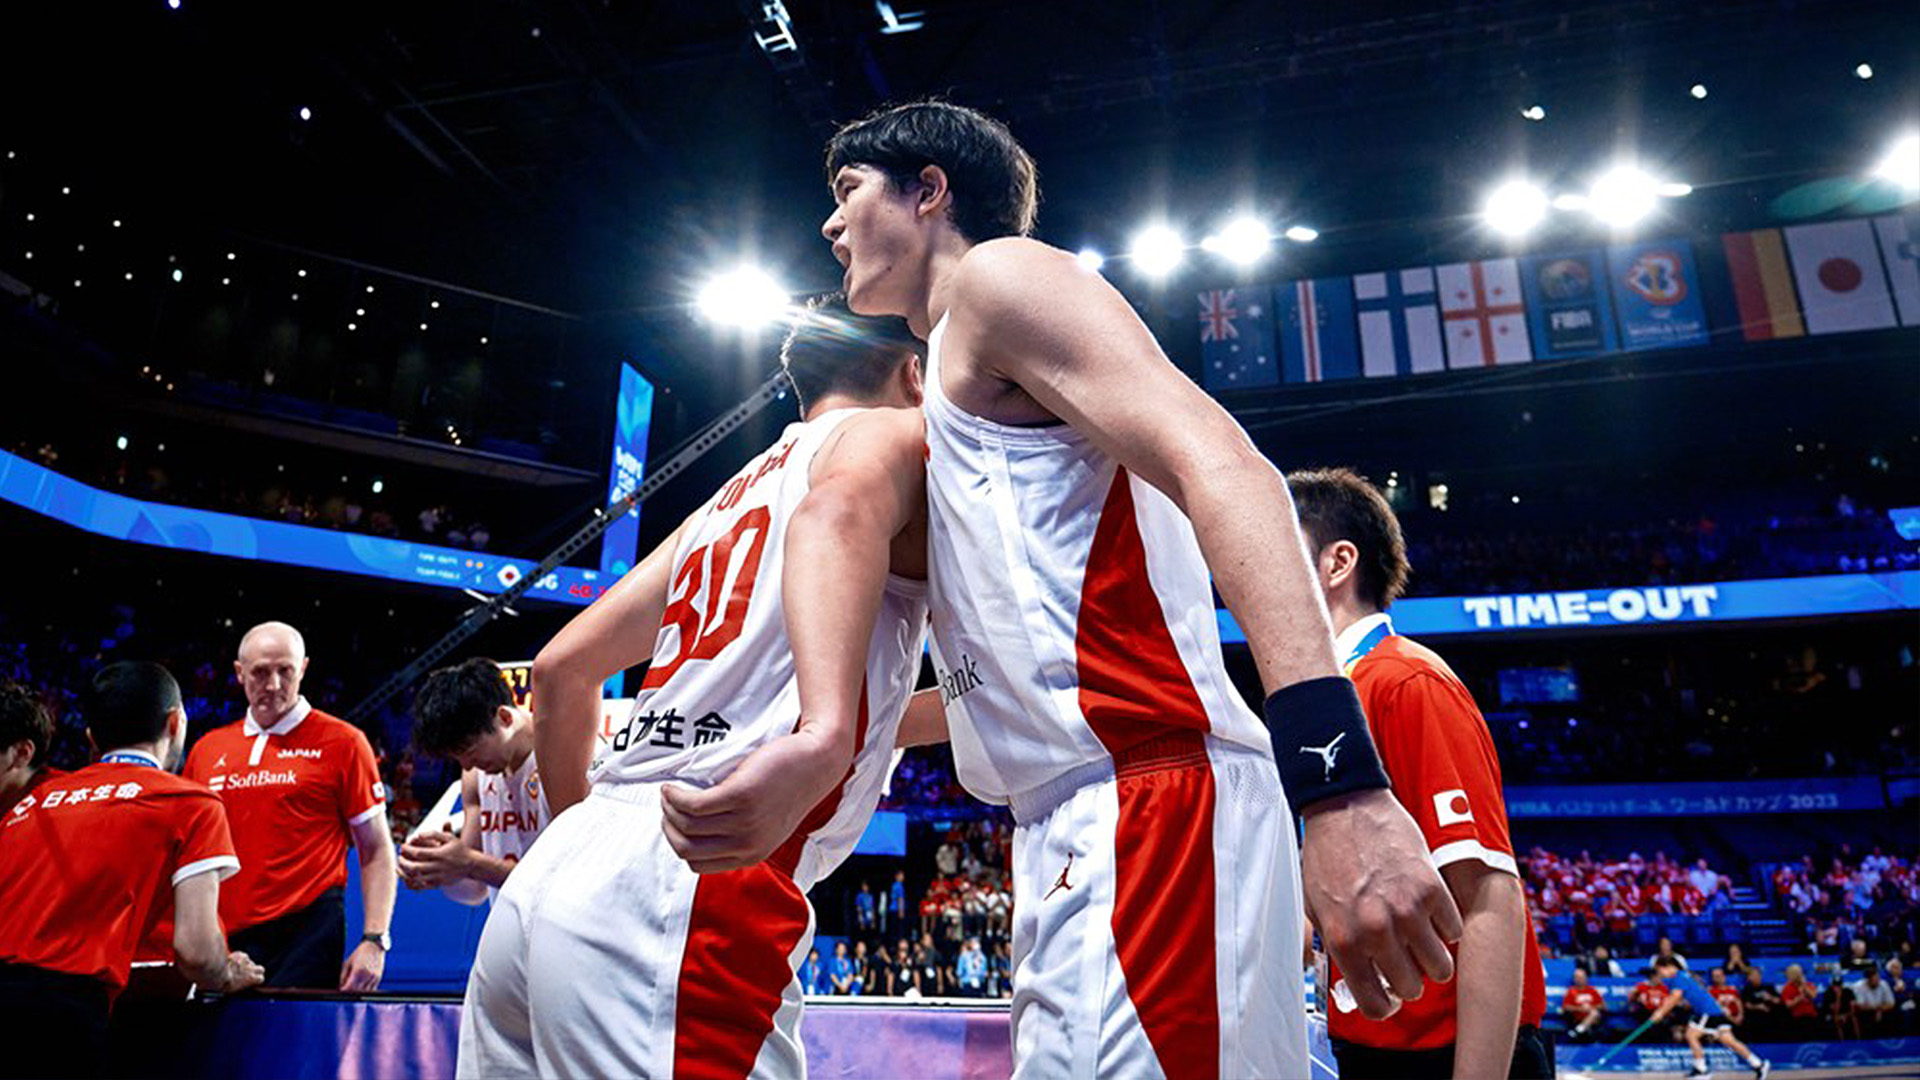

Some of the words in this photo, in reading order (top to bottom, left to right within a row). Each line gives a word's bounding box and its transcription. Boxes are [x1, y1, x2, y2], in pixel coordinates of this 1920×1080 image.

[640, 504, 771, 690] 30
[1463, 585, 1719, 628] TIME-OUT
[277, 747, 322, 759] JAPAN
[226, 769, 297, 790] SoftBank
[41, 782, 143, 808] 日本生命
[1788, 793, 1839, 809] 2023
[480, 810, 539, 832] JAPAN
